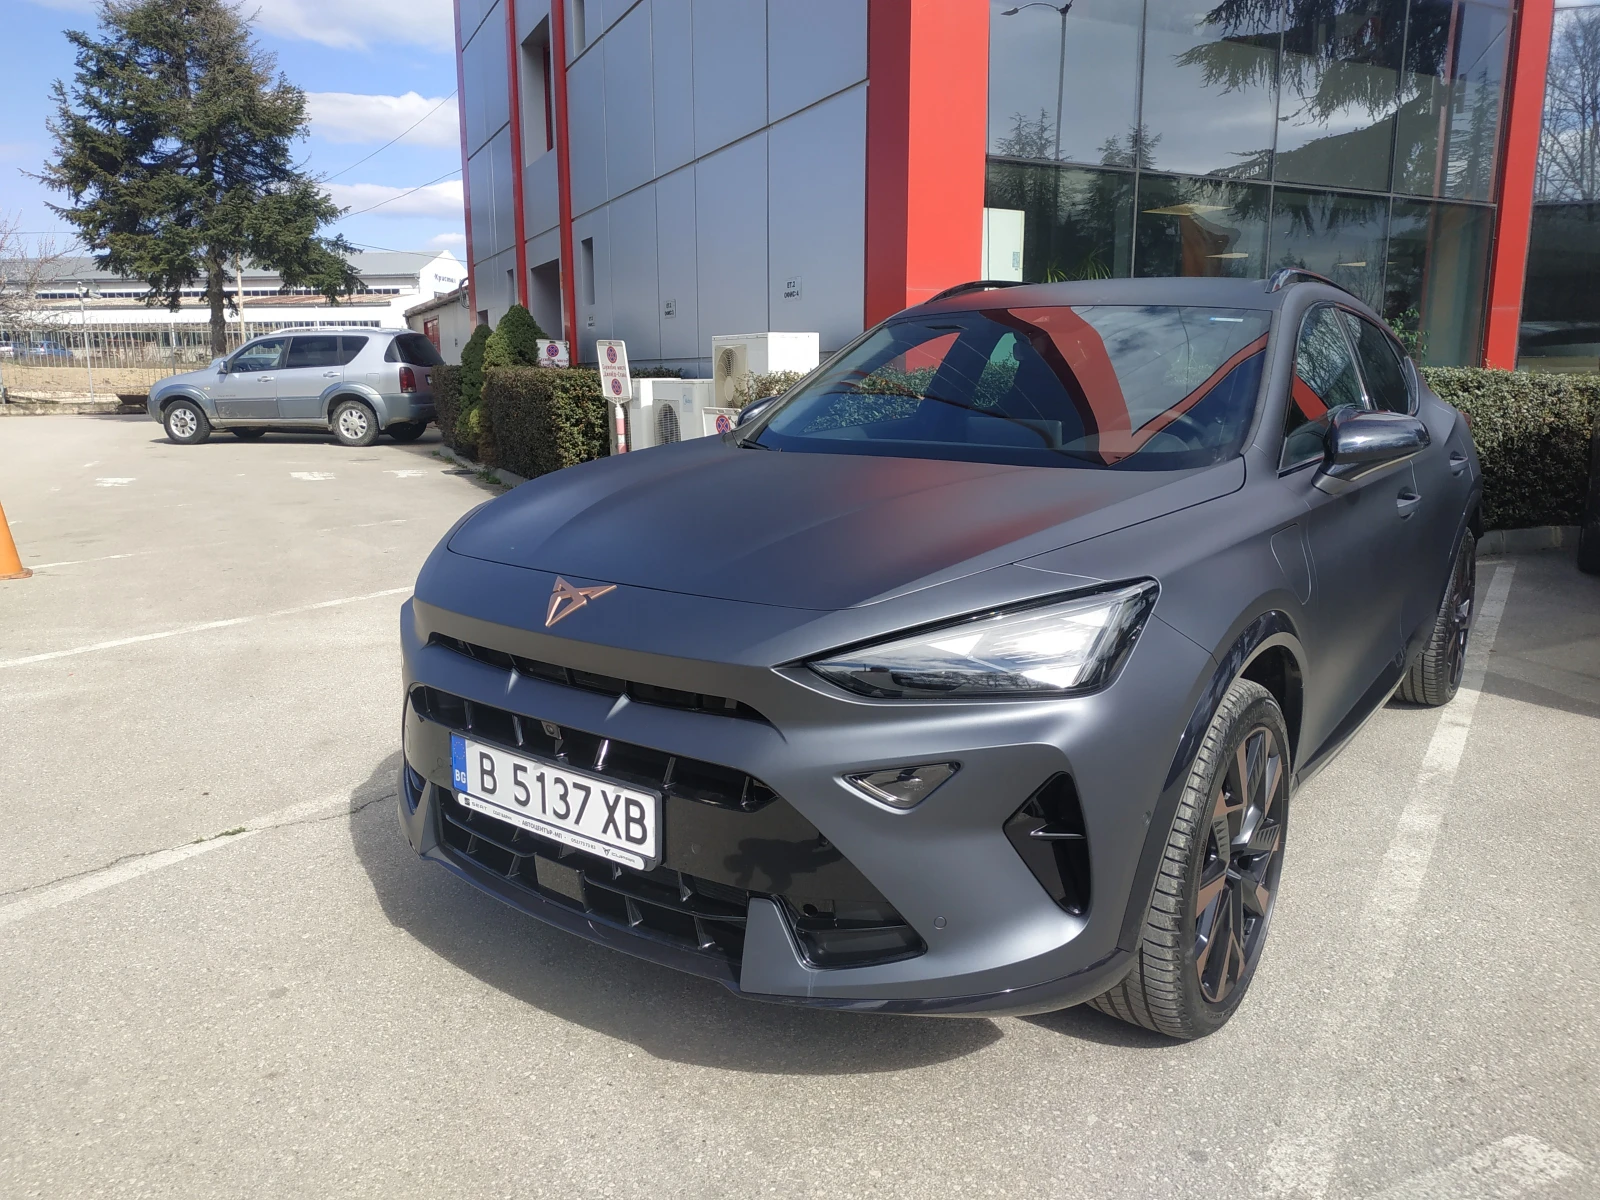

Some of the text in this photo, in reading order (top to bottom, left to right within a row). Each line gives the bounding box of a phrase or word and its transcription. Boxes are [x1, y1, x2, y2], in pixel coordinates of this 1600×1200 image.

[455, 769, 466, 784] BG
[479, 751, 648, 846] B 5137 XB
